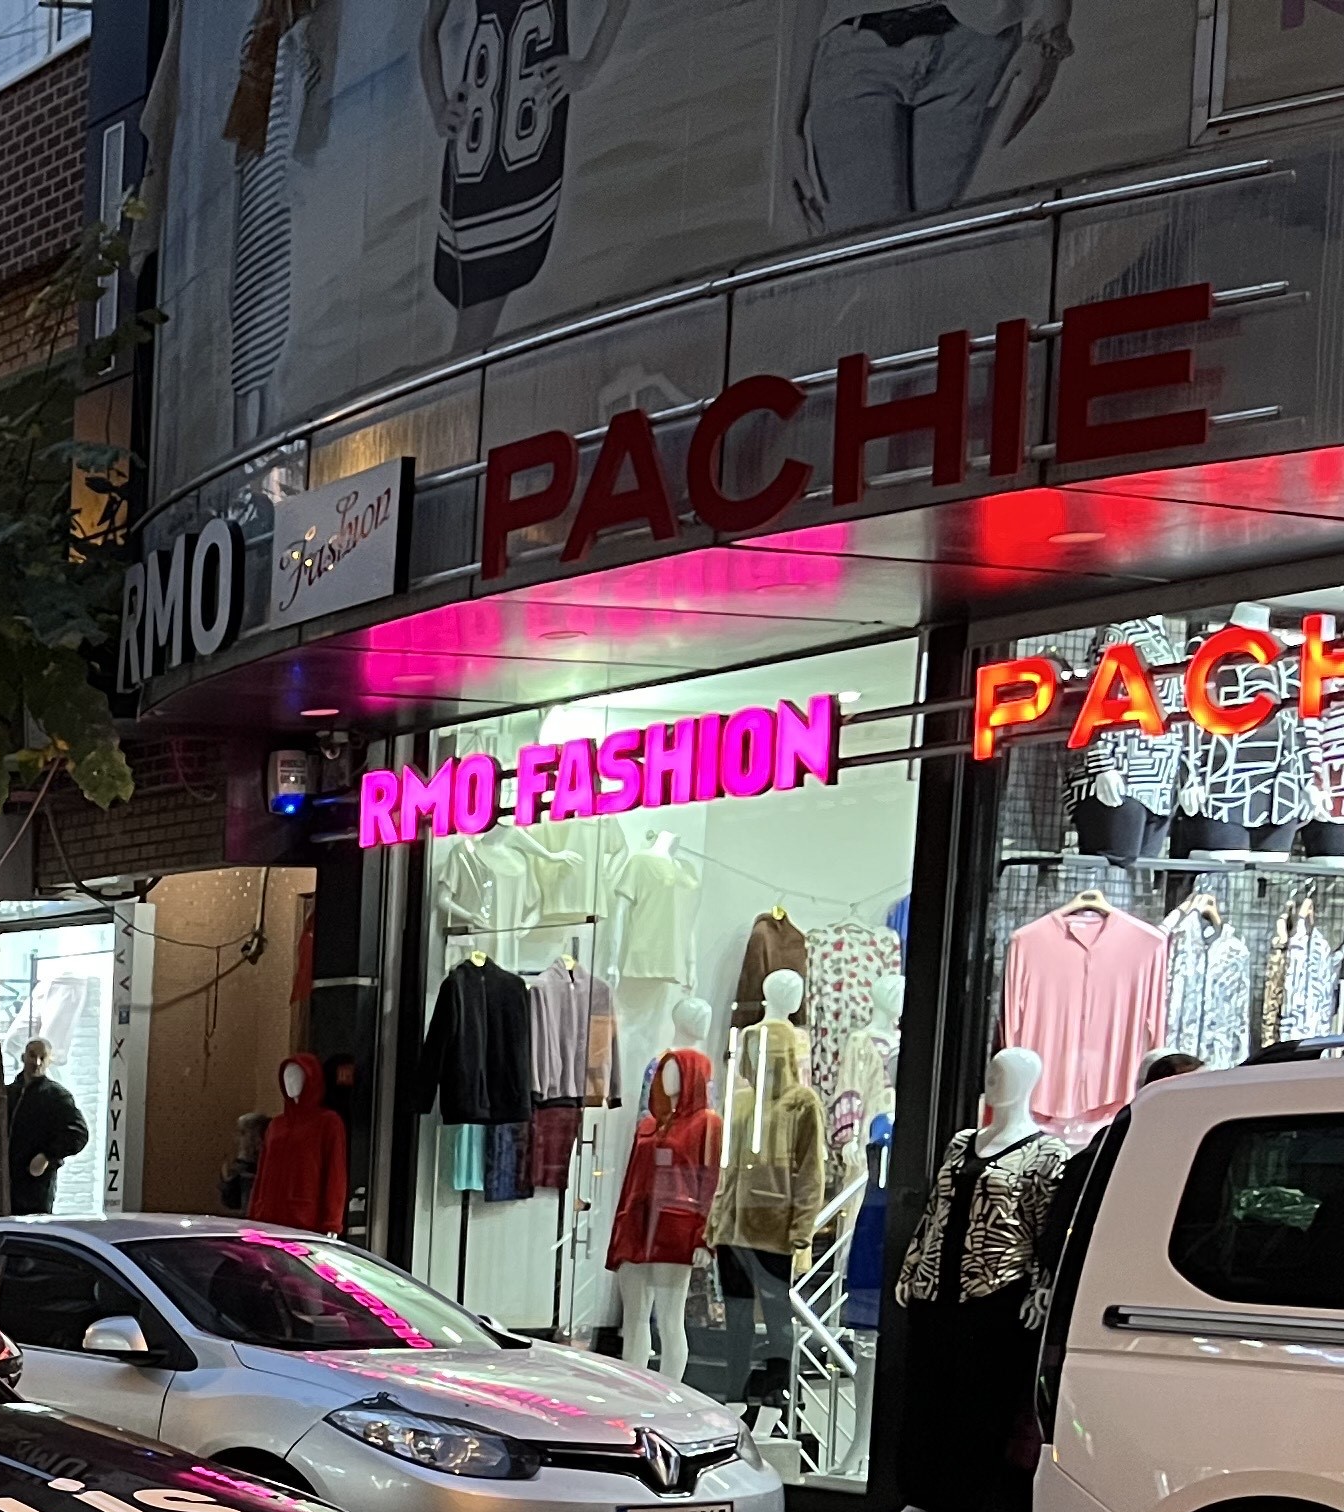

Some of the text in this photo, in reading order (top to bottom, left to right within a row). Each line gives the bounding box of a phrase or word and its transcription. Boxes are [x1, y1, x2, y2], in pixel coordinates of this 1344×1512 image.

[452, 0, 555, 183] 86
[480, 282, 1214, 581] PACHIE
[116, 518, 234, 693] RMO
[358, 694, 838, 848] RMO FASHION
